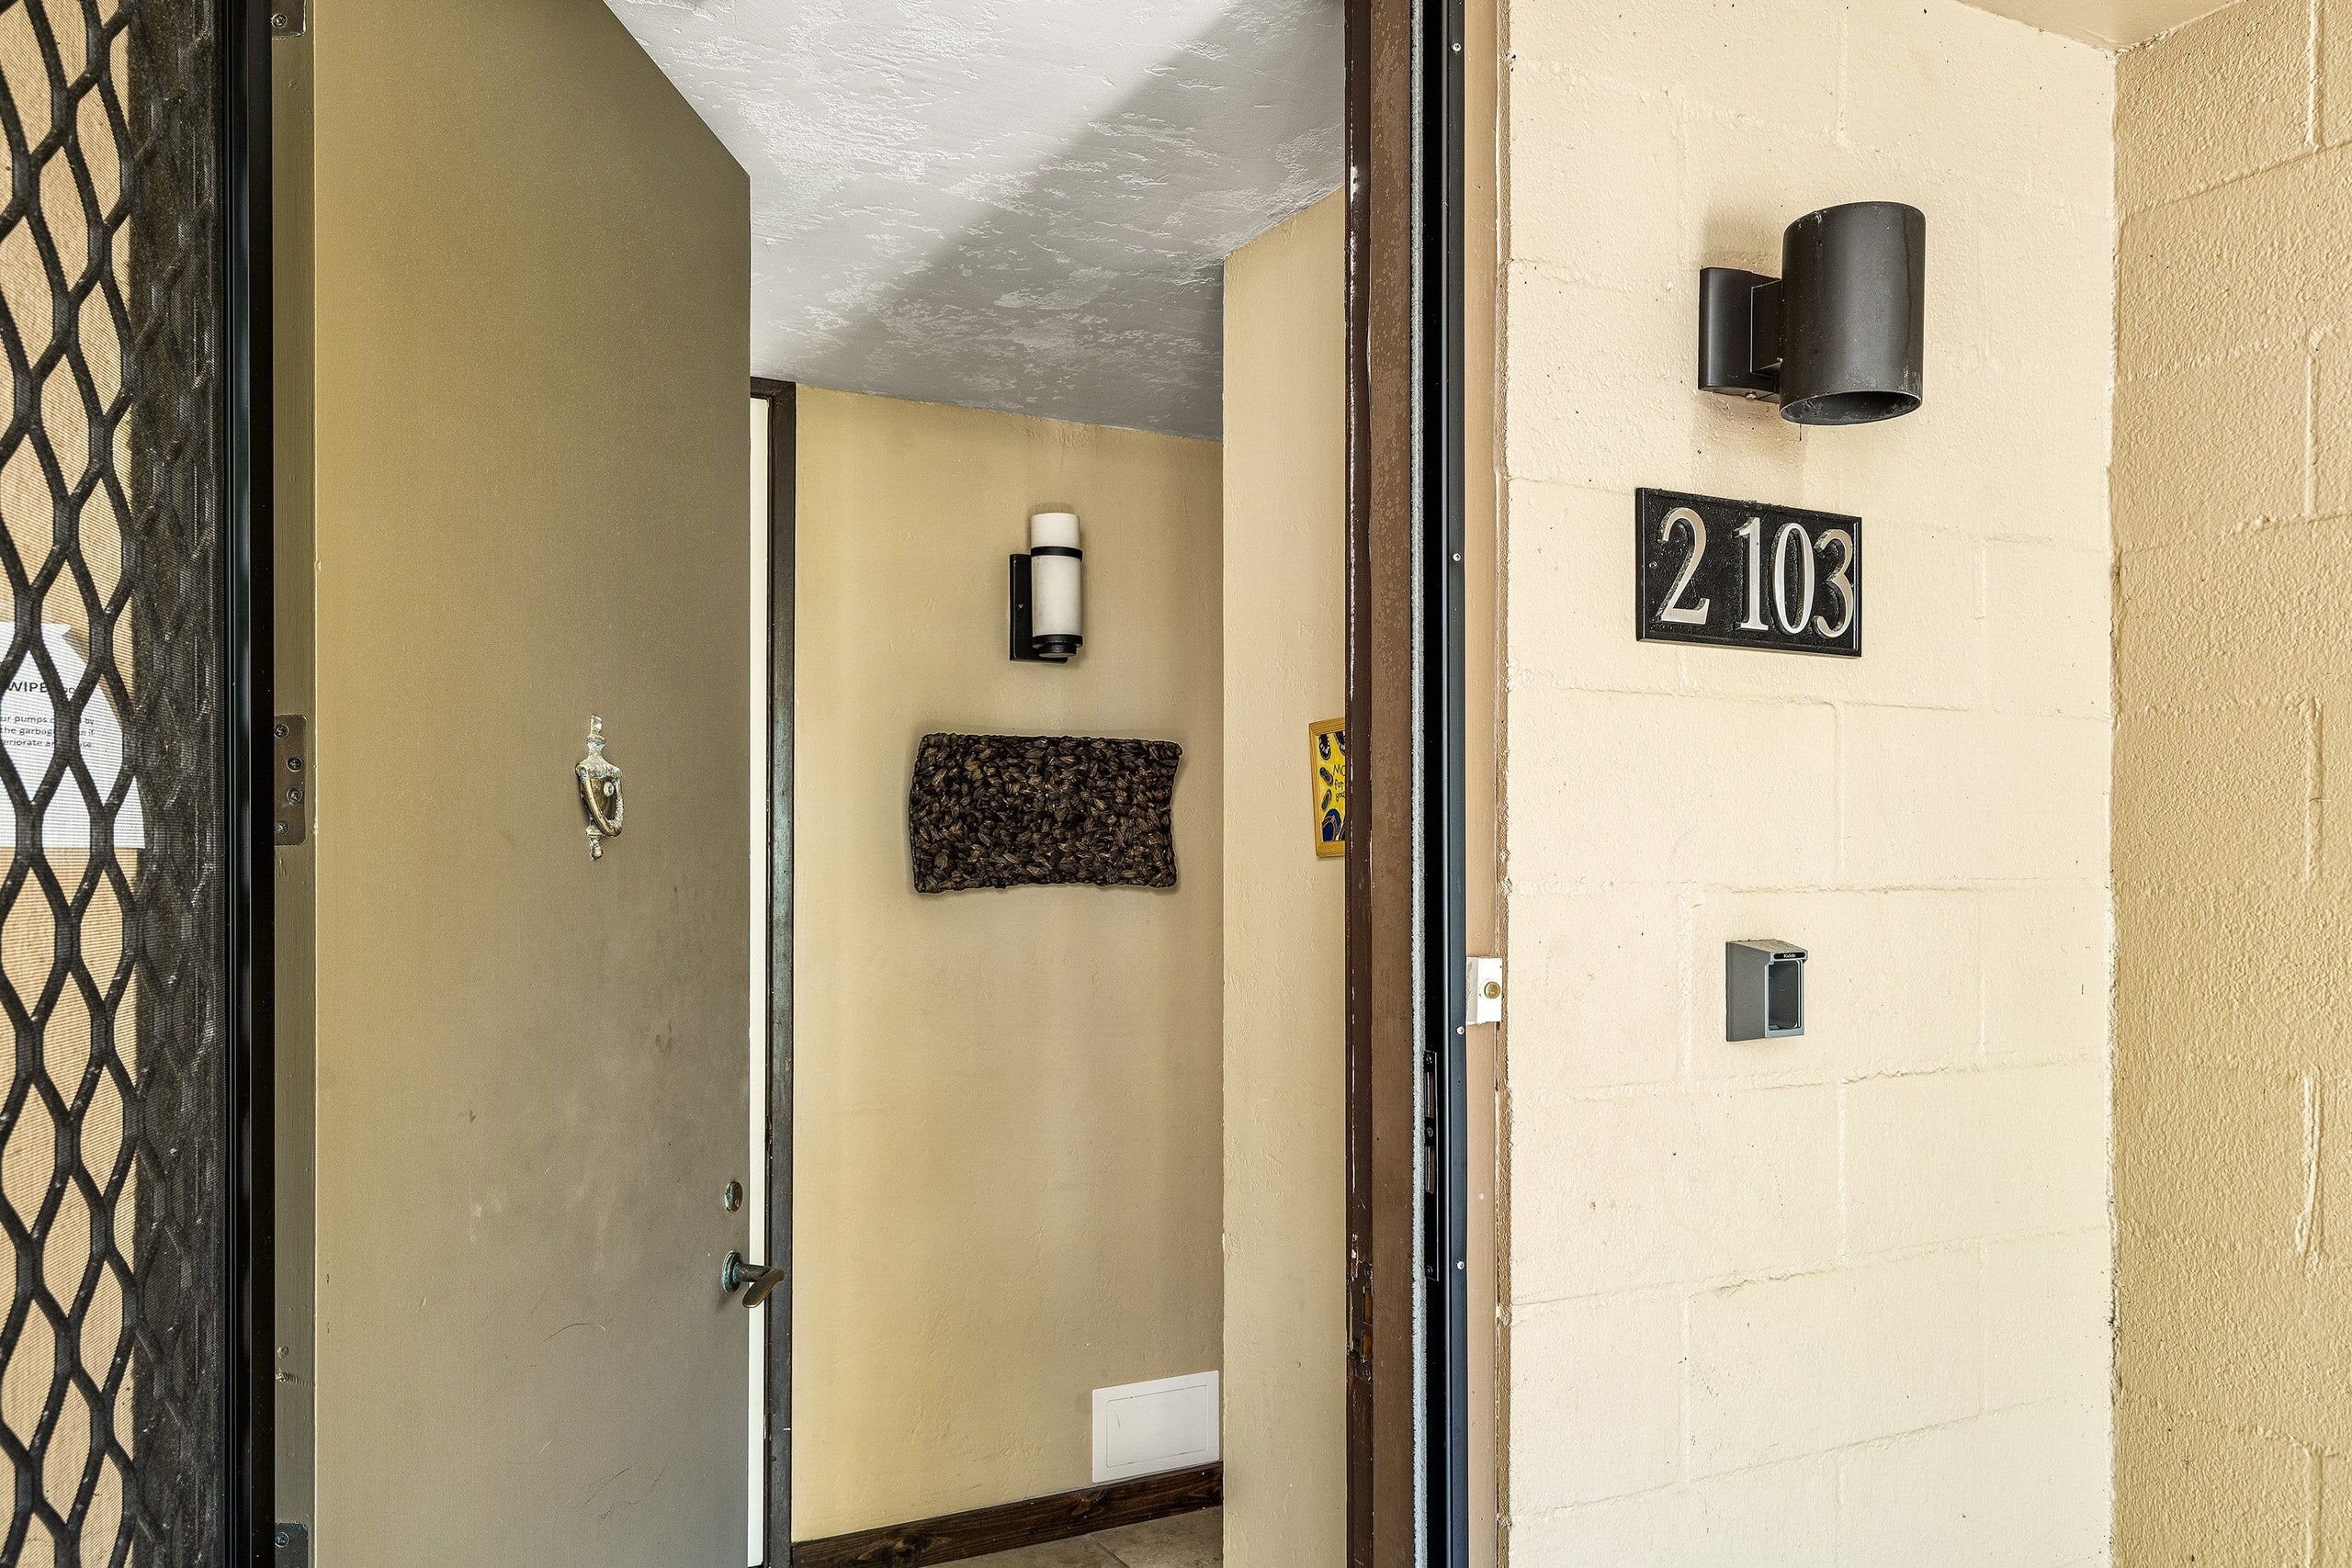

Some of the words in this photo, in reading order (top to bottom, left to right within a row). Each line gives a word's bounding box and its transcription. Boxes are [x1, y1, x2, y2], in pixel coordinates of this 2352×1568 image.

[1655, 507, 1711, 625] 2
[1733, 516, 1854, 638] 103
[14, 716, 48, 725] pumps
[19, 728, 53, 737] garbag
